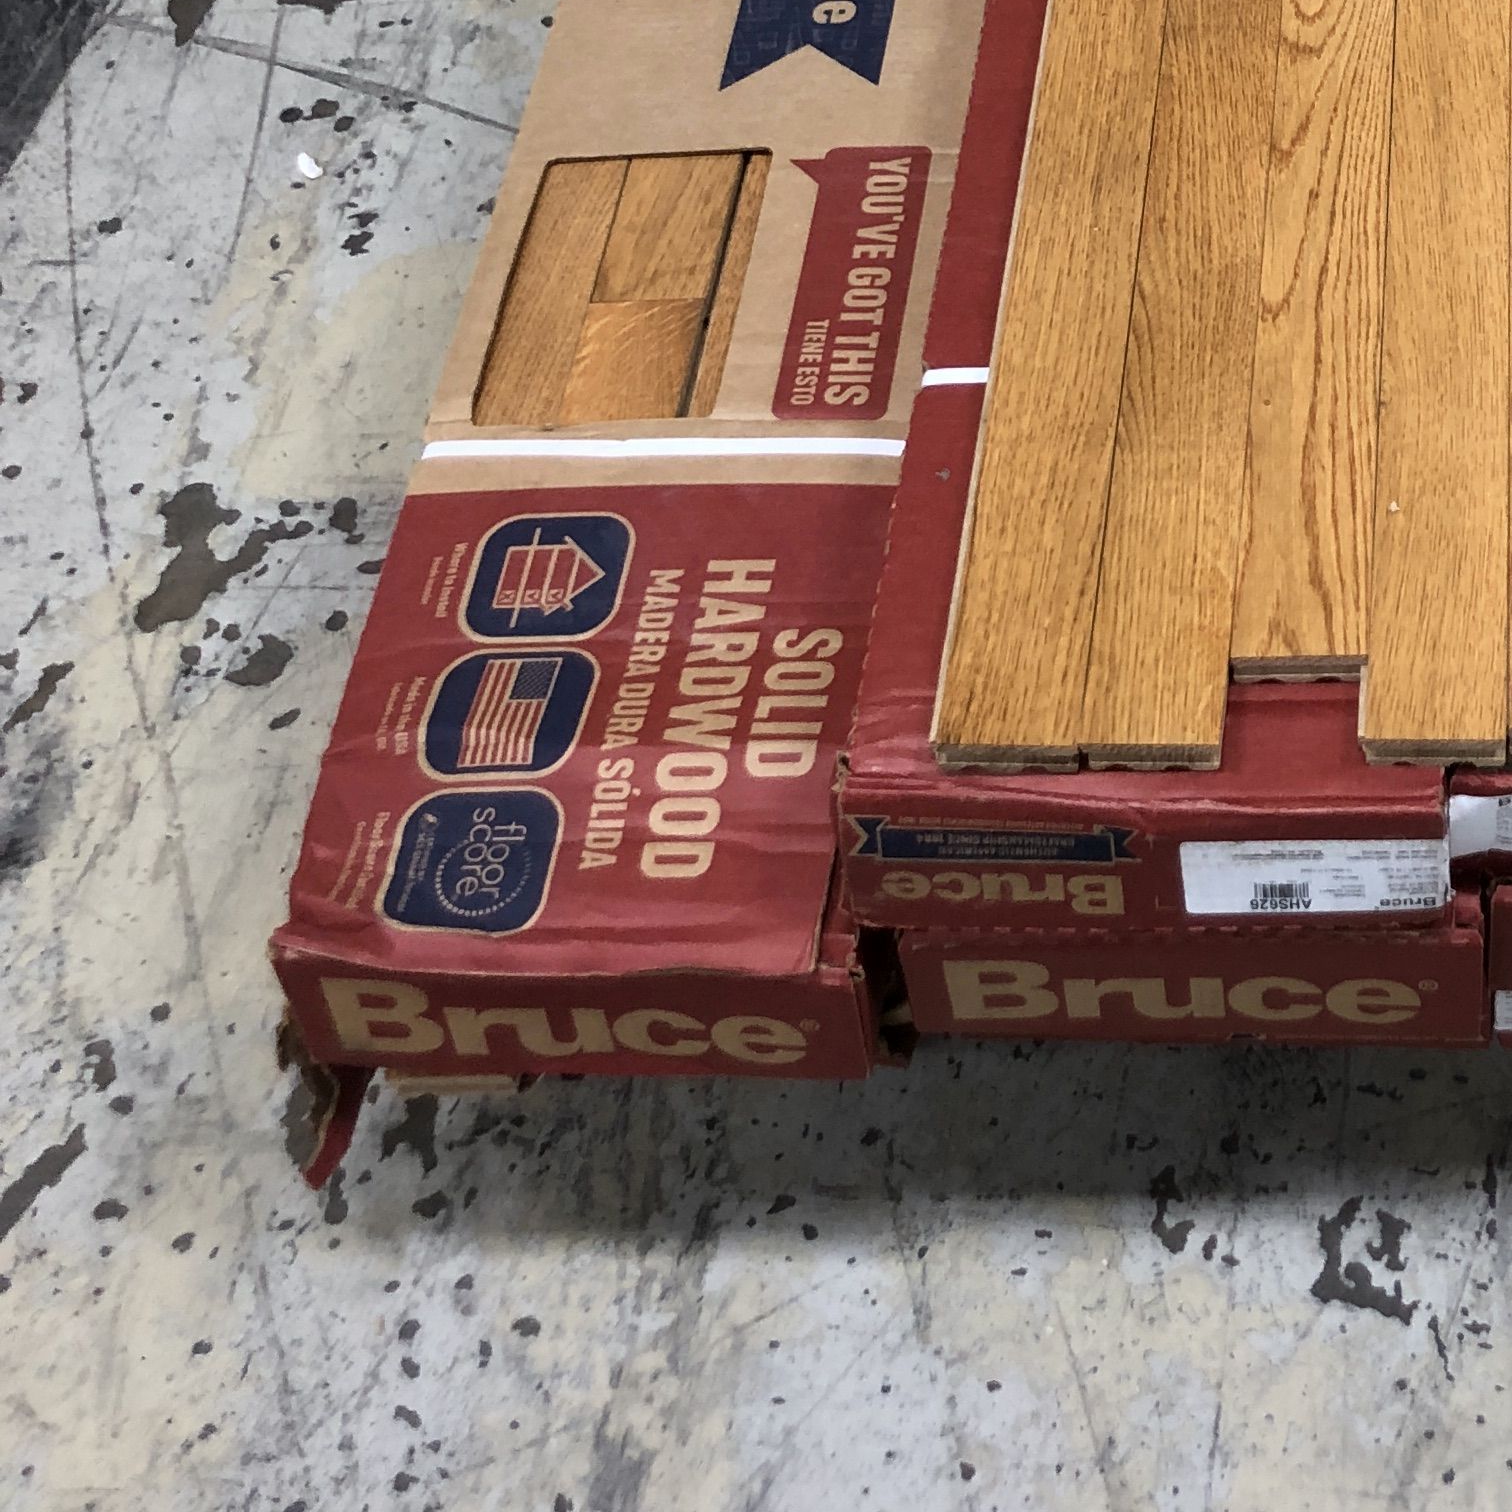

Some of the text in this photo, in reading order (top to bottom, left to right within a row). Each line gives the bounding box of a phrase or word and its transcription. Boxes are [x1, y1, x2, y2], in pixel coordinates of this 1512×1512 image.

[823, 156, 912, 407] YOU'VE GOT THIS
[790, 318, 830, 406] TIENE ESTO
[579, 568, 686, 871] MADERA DURA SÓLIDA
[640, 558, 777, 880] HARDWOOD
[744, 627, 843, 779] SOLID
[456, 807, 496, 896] score
[479, 821, 527, 899] floor
[881, 870, 1125, 916] Bruce
[320, 976, 807, 1064] Bruce
[943, 960, 1422, 1022] Bruce
